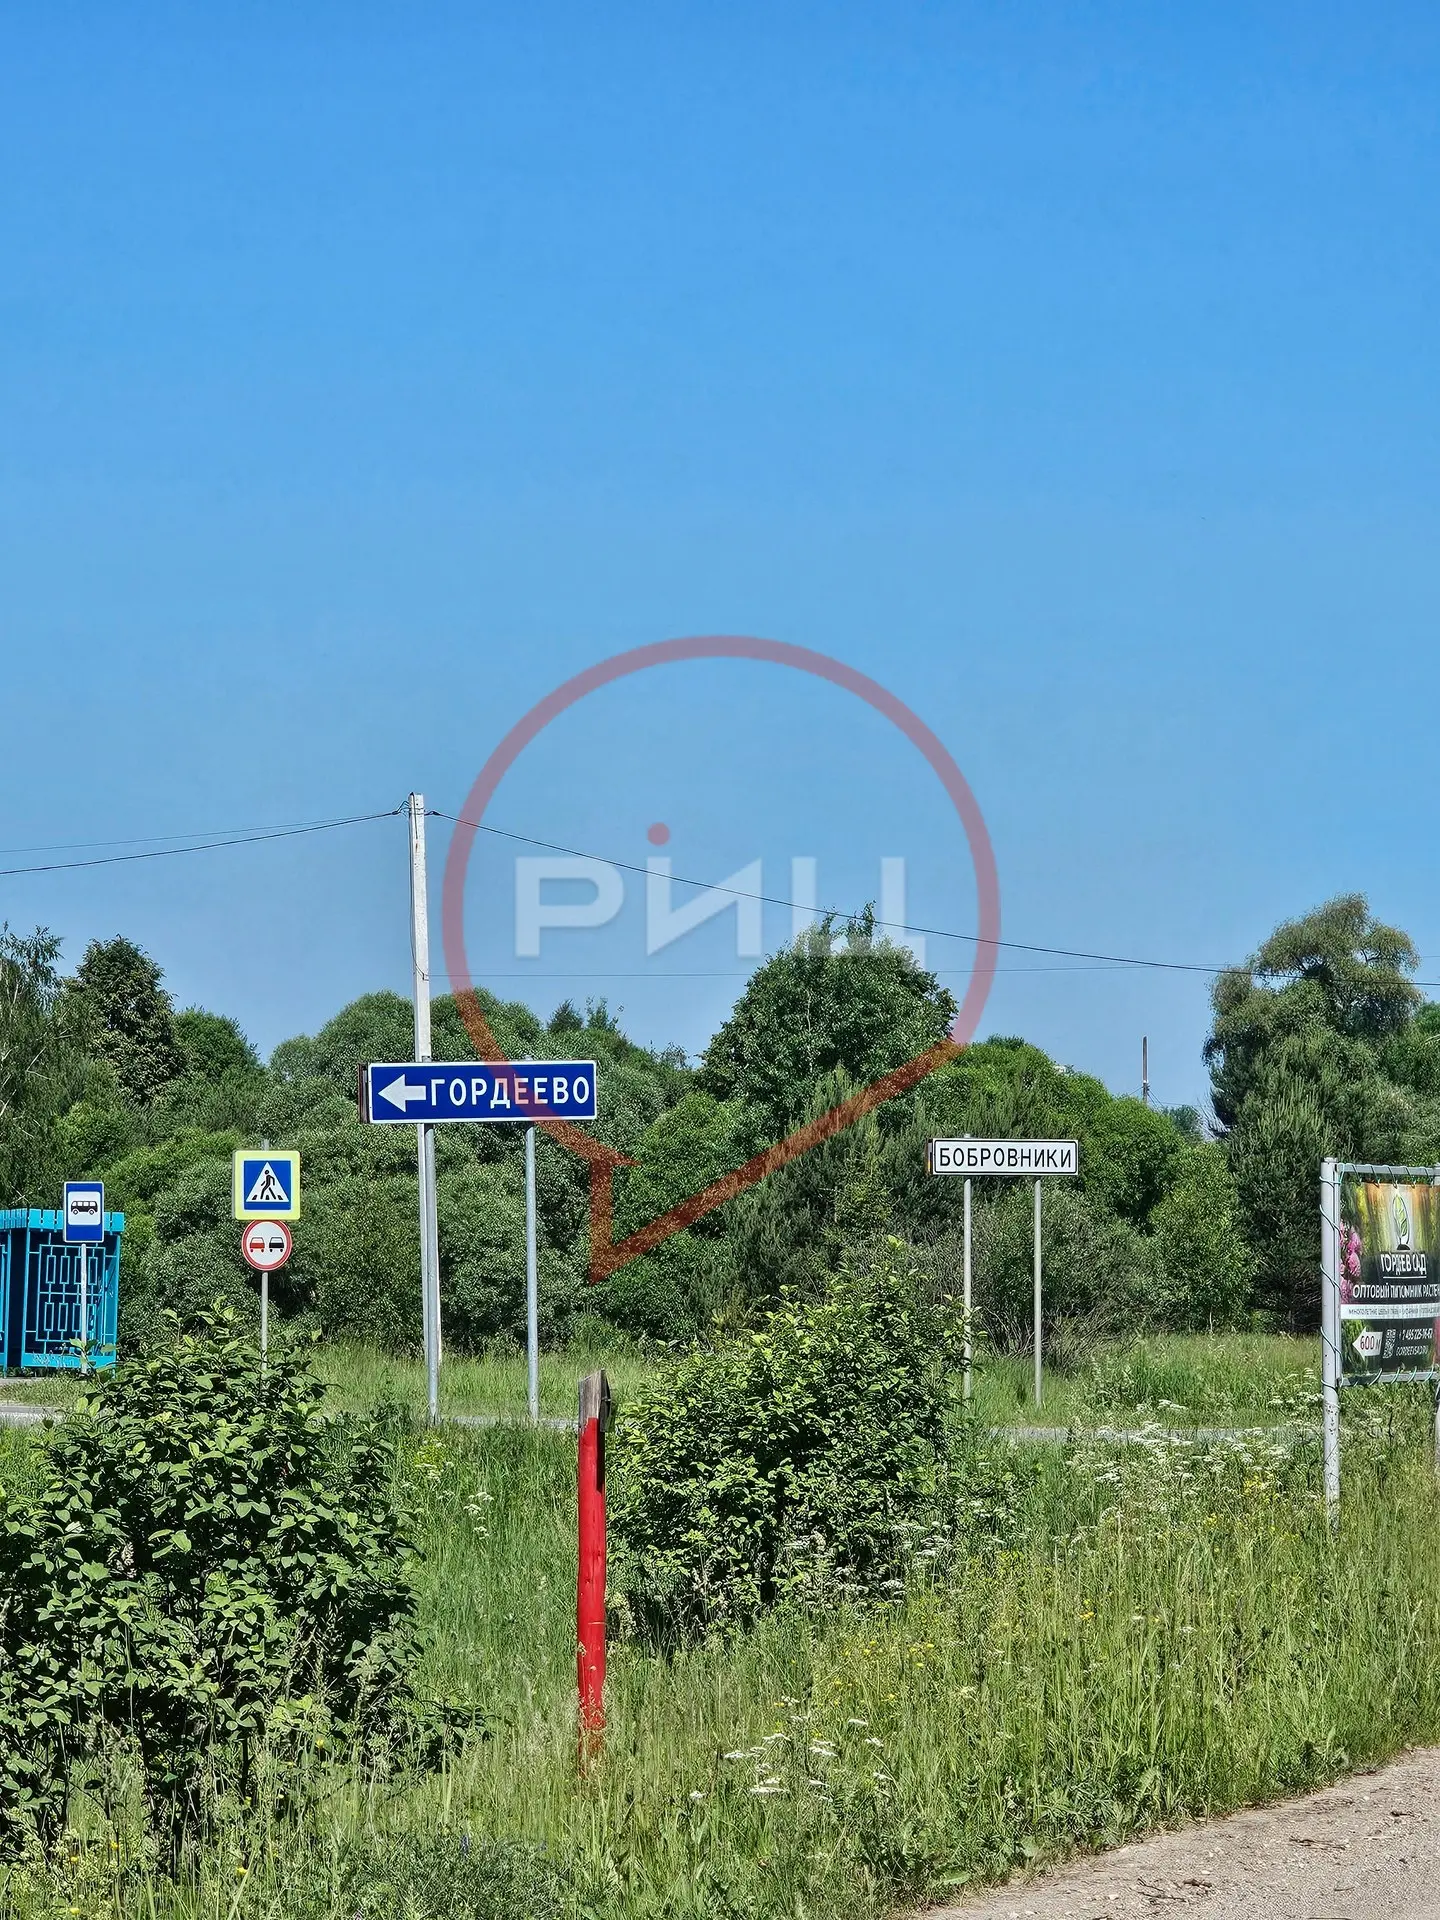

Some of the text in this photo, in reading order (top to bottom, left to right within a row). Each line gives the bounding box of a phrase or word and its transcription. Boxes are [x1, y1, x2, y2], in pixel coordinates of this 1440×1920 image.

[430, 1075, 590, 1109] ГОРДЕЕВО
[939, 1147, 1072, 1168] БОБРОВНИКИ
[1412, 1253, 1427, 1275] САД
[1352, 1282, 1389, 1298] ОПТОВЫЙ
[1360, 1336, 1375, 1350] 600
